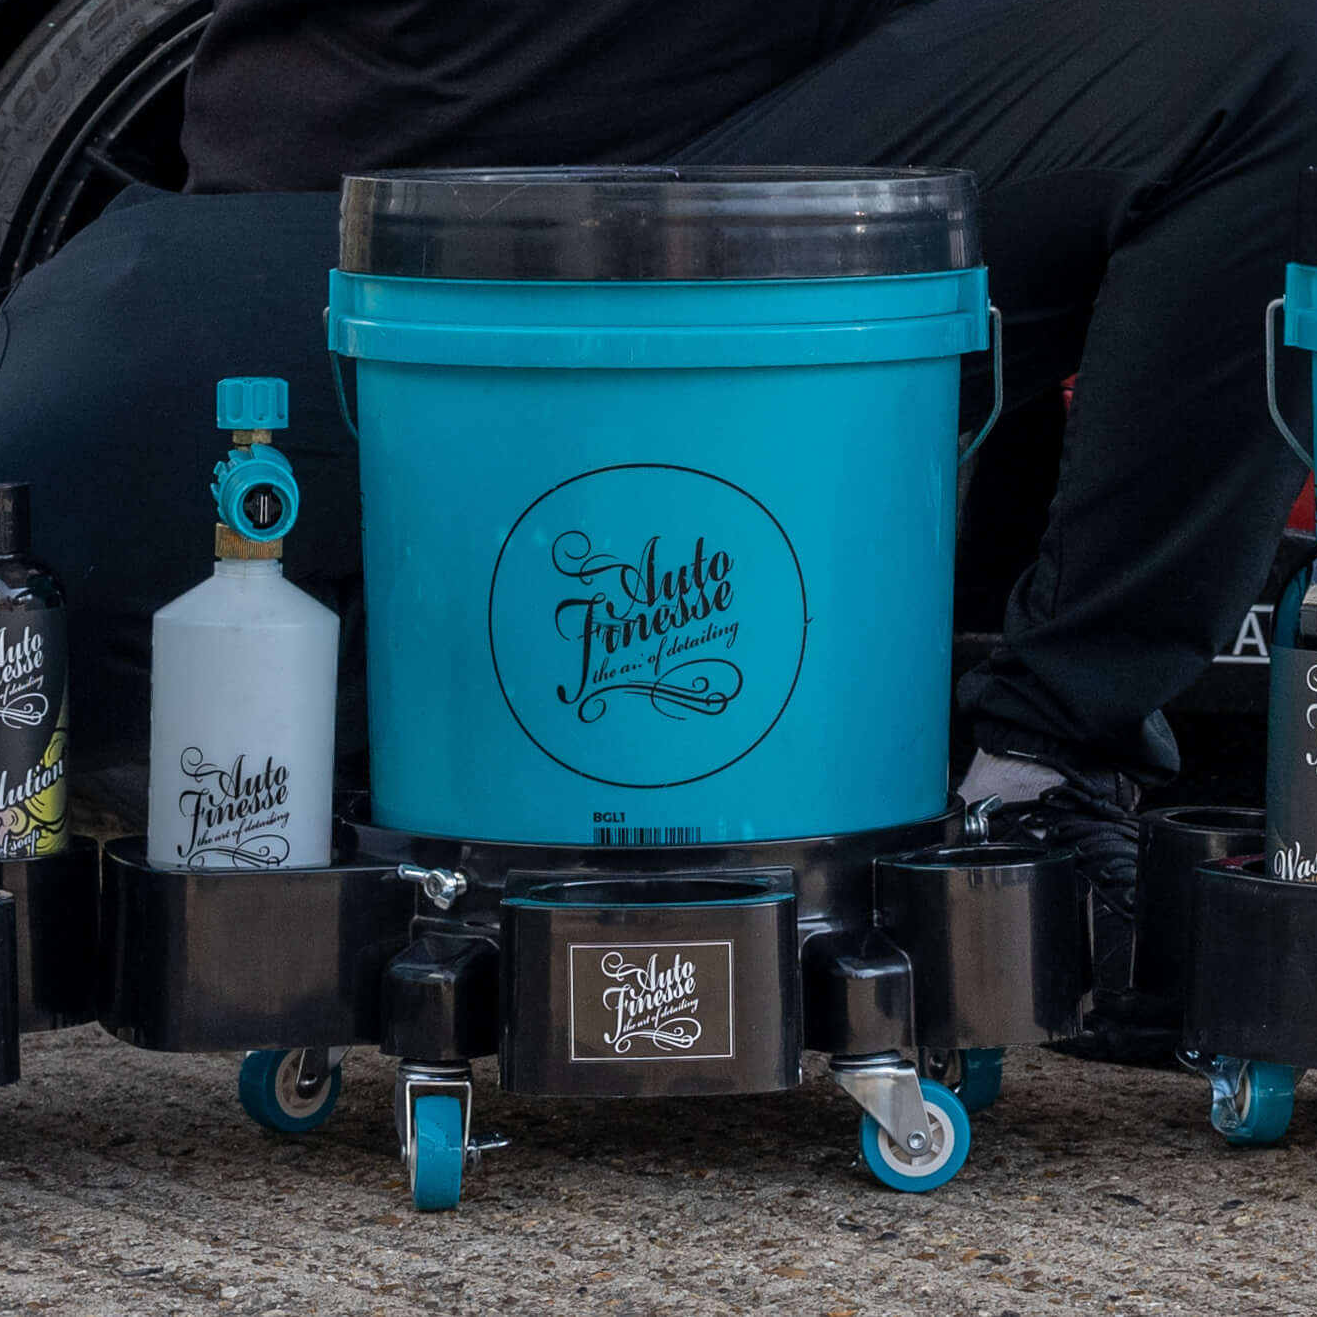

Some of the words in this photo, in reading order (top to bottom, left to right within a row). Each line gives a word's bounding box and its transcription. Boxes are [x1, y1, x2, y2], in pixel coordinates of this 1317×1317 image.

[552, 530, 735, 620] Auto
[555, 580, 735, 704] Finesse
[592, 657, 616, 684] the
[647, 636, 667, 676] of
[666, 621, 739, 657] detailing
[180, 746, 290, 807] Auto
[177, 785, 289, 859] Finesse
[593, 811, 625, 823] BGL1
[601, 952, 697, 1000] Auto
[603, 977, 697, 1044] Finesse
